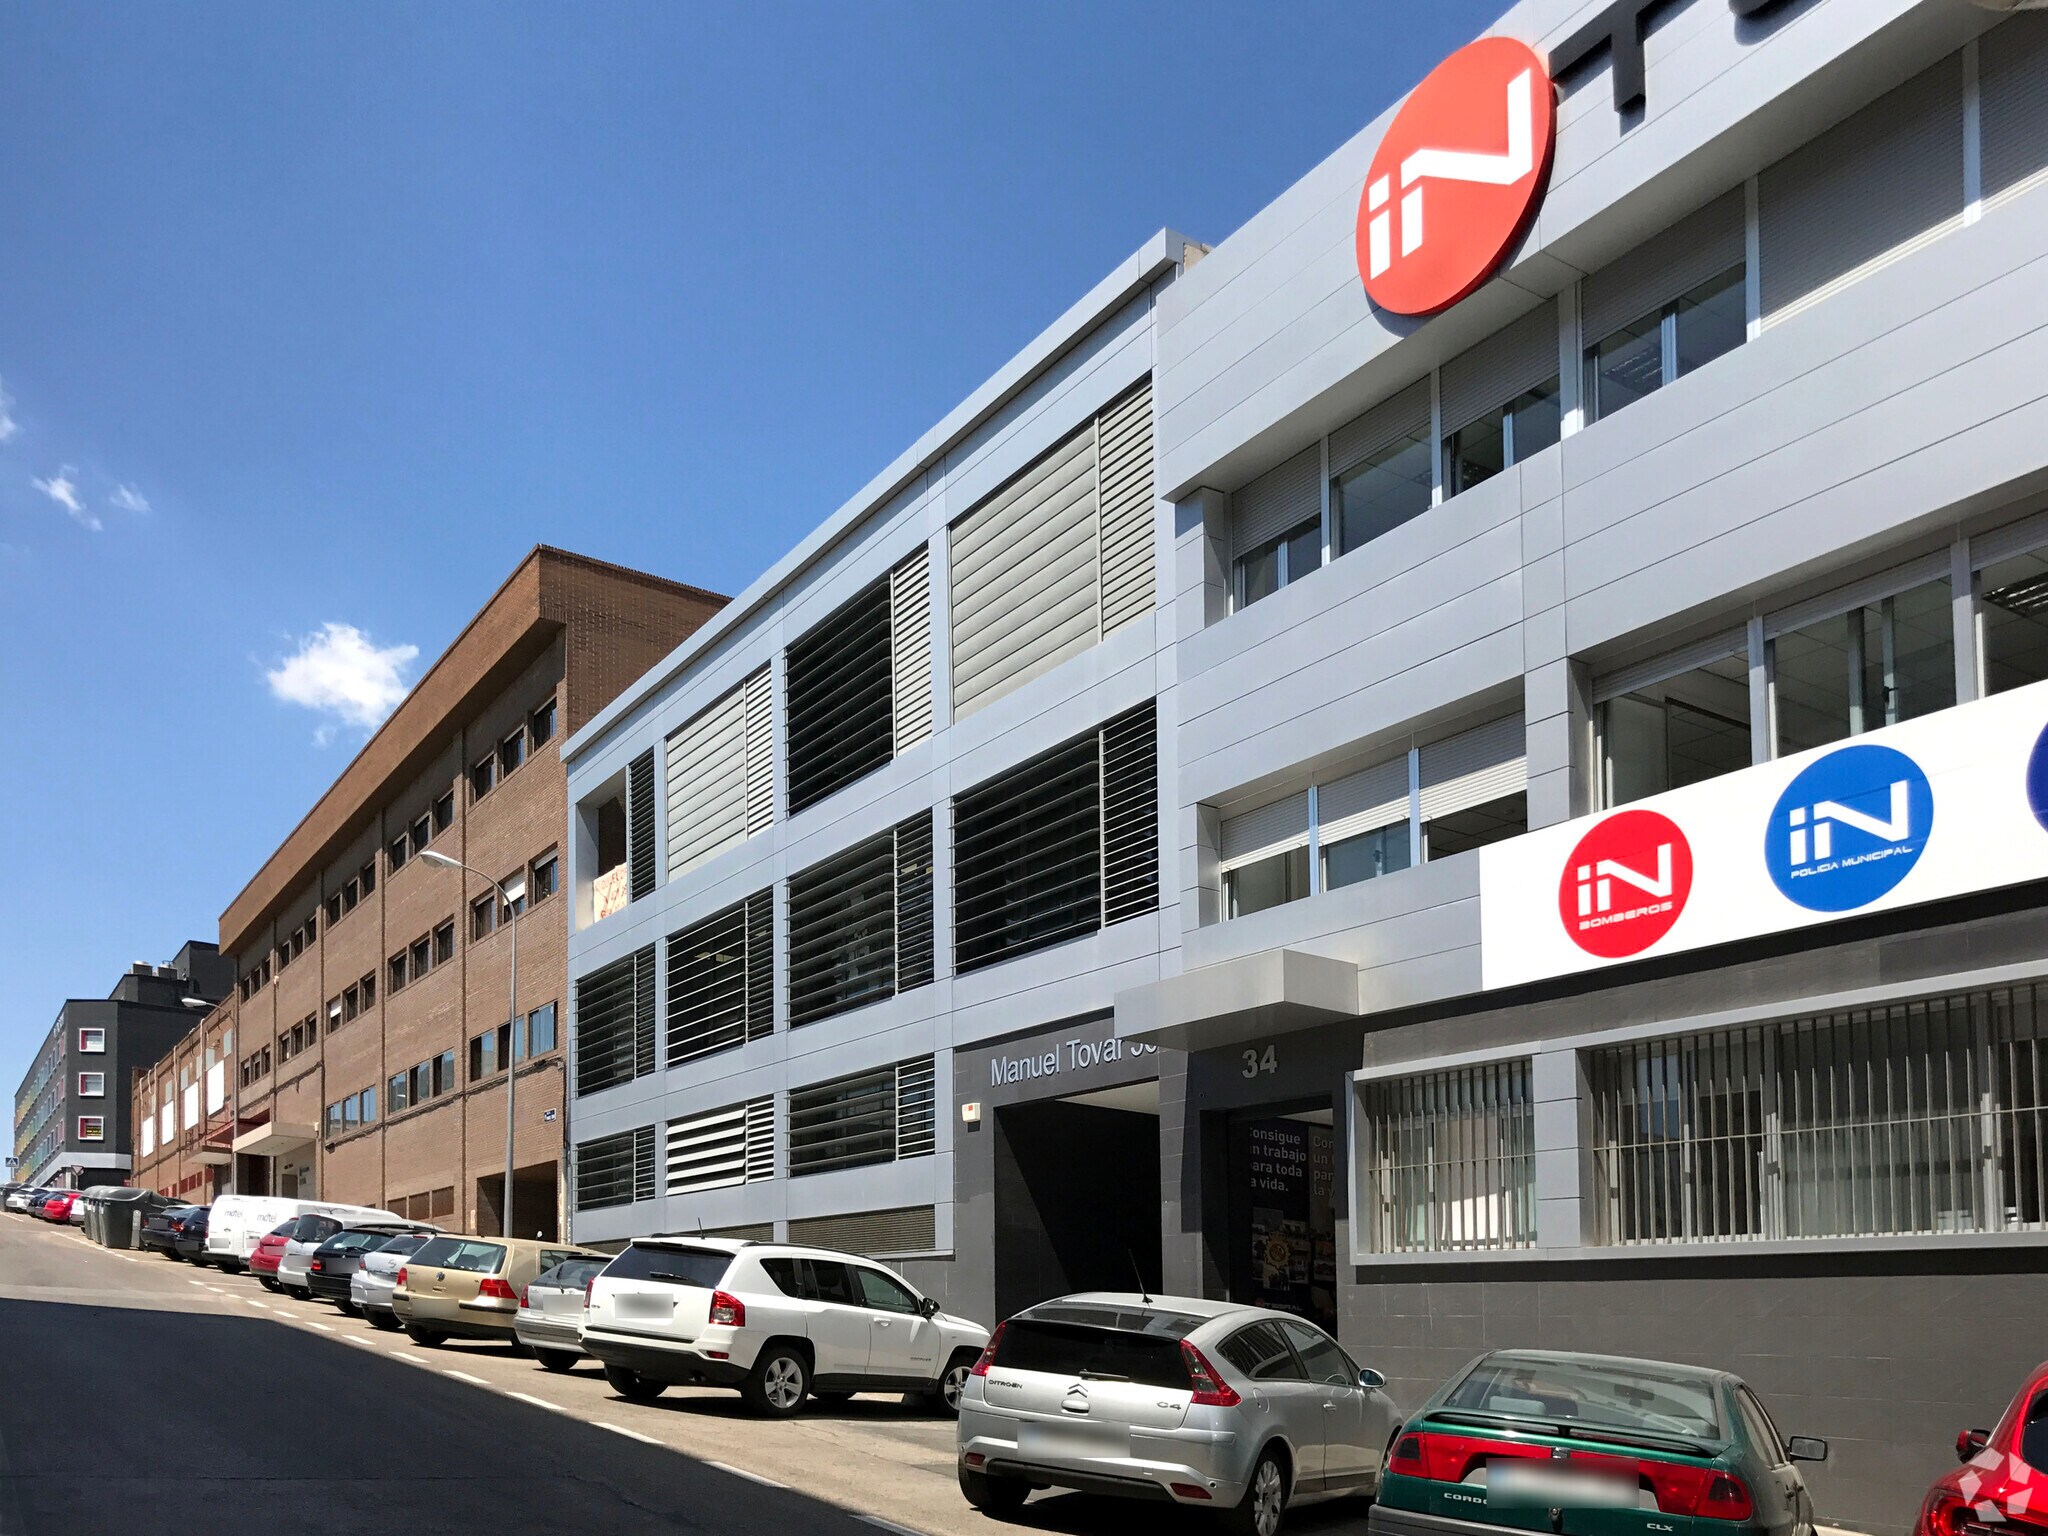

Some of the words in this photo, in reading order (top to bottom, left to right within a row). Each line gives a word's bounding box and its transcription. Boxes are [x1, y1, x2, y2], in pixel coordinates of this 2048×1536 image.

[1790, 862, 1839, 879] POLICIA
[1842, 845, 1913, 868] MUNICIPAL
[1578, 901, 1673, 931] BOMBEROS
[991, 1044, 1060, 1087] Manuel
[1066, 1038, 1123, 1070] Tovar
[1242, 1045, 1278, 1079] 34
[1263, 1145, 1307, 1163] trabajo
[1250, 1162, 1273, 1173] ara
[1276, 1163, 1303, 1177] toda
[1260, 1177, 1289, 1192] vida.
[1157, 1401, 1181, 1411] C4
[1646, 1523, 1674, 1532] CLX
